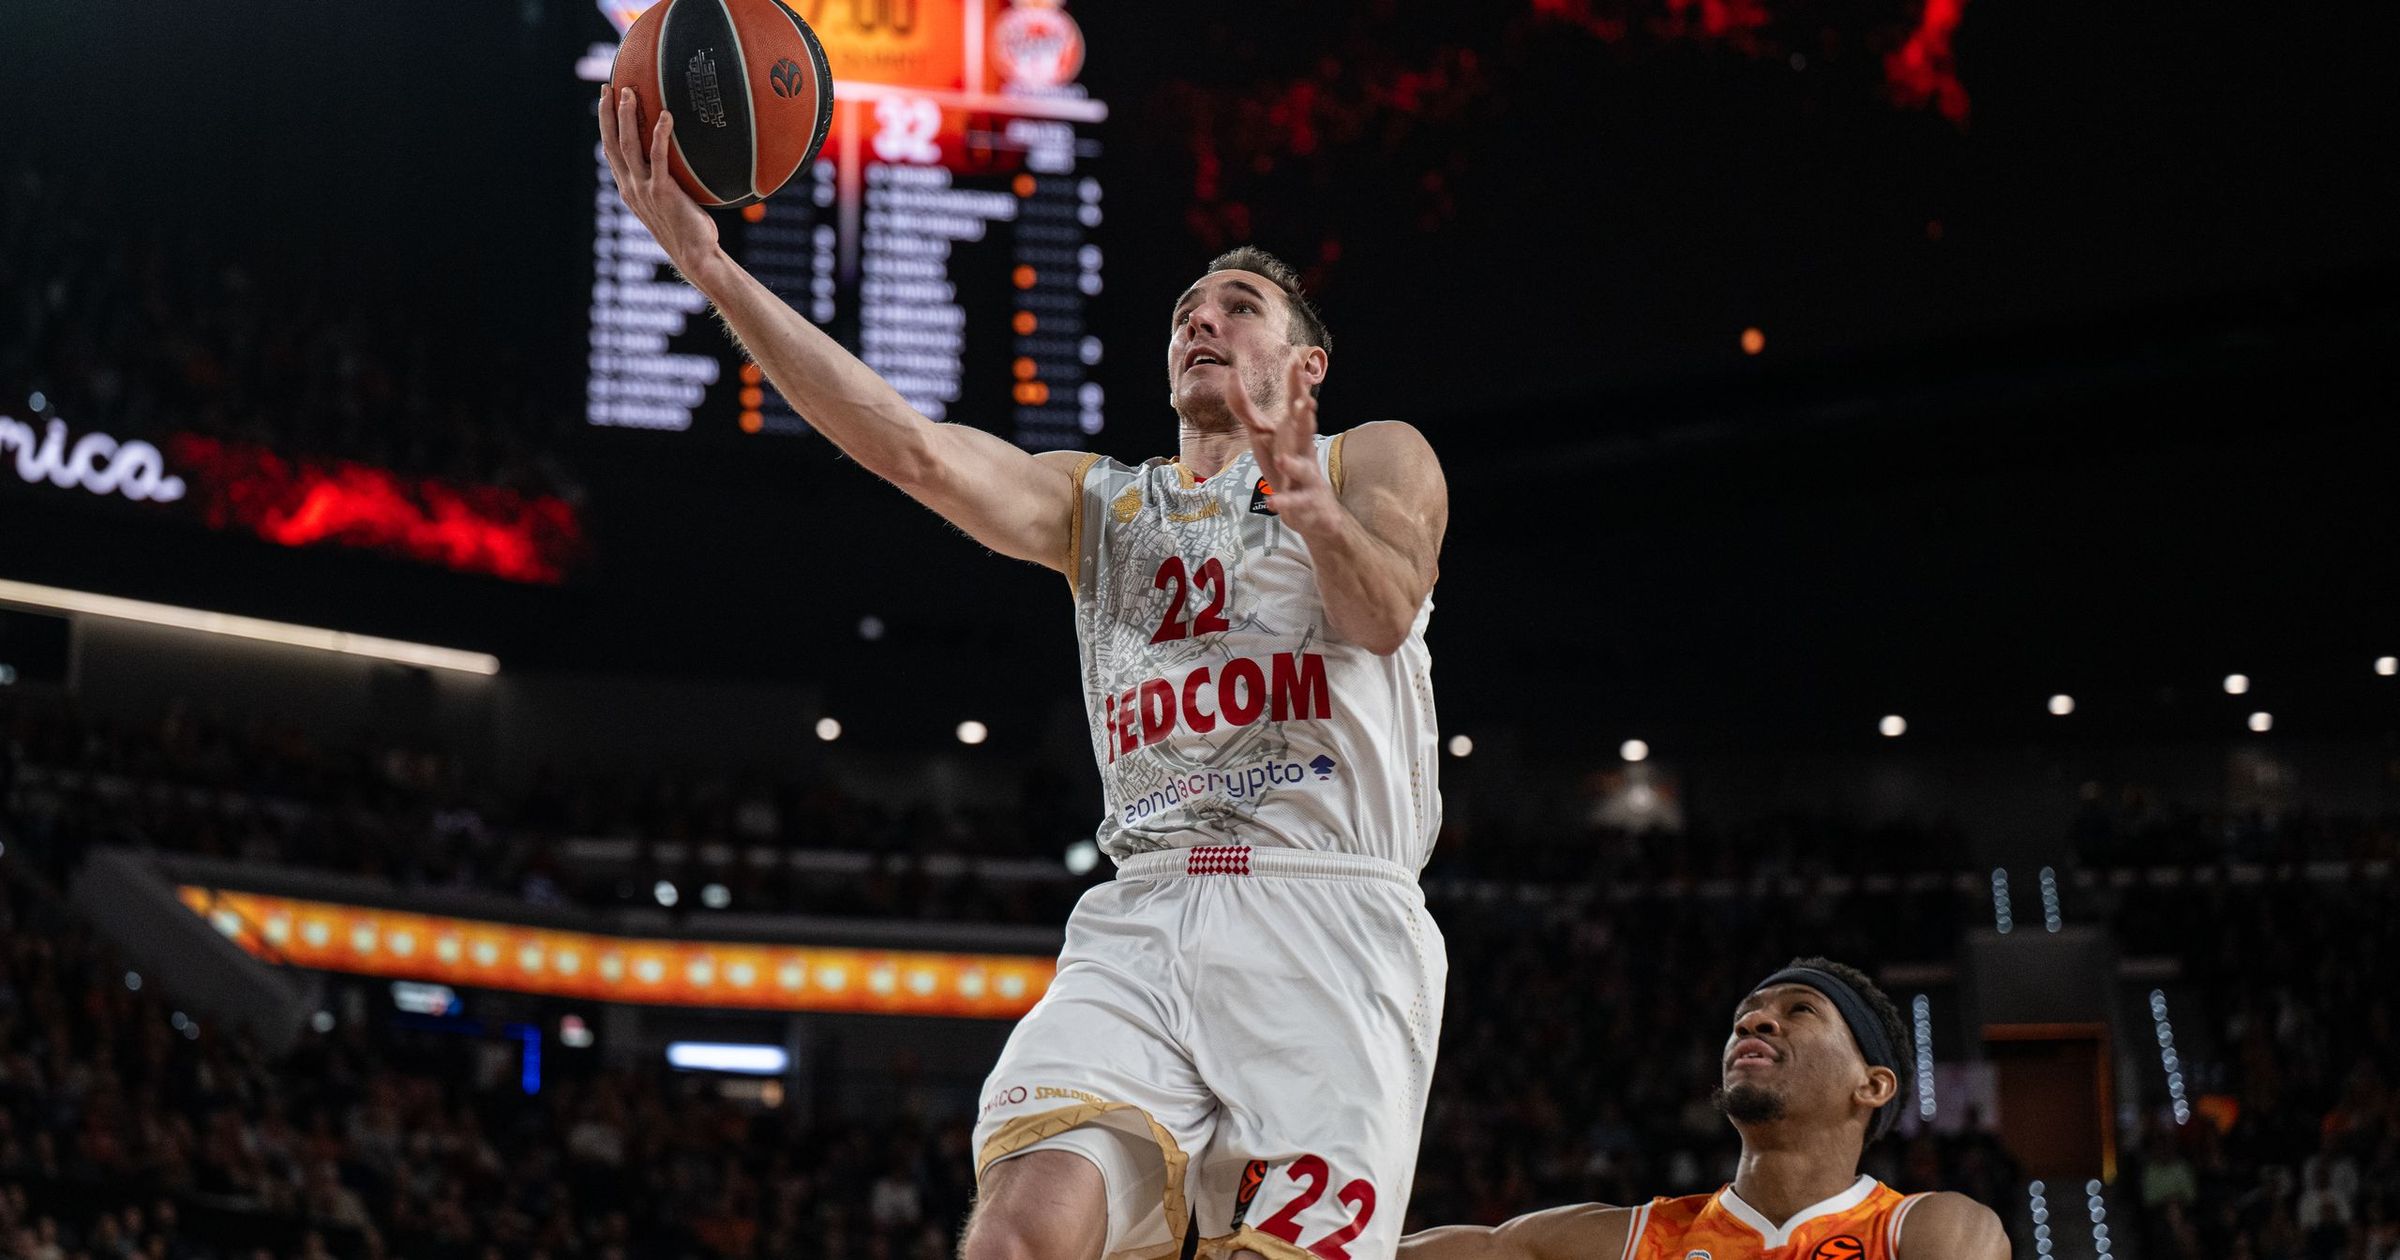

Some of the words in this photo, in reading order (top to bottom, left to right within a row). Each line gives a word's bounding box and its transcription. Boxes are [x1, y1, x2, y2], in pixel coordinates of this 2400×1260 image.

[872, 94, 943, 164] 32
[1149, 555, 1230, 645] 22
[1124, 760, 1305, 824] zondacrypto
[1256, 1154, 1376, 1260] 22
